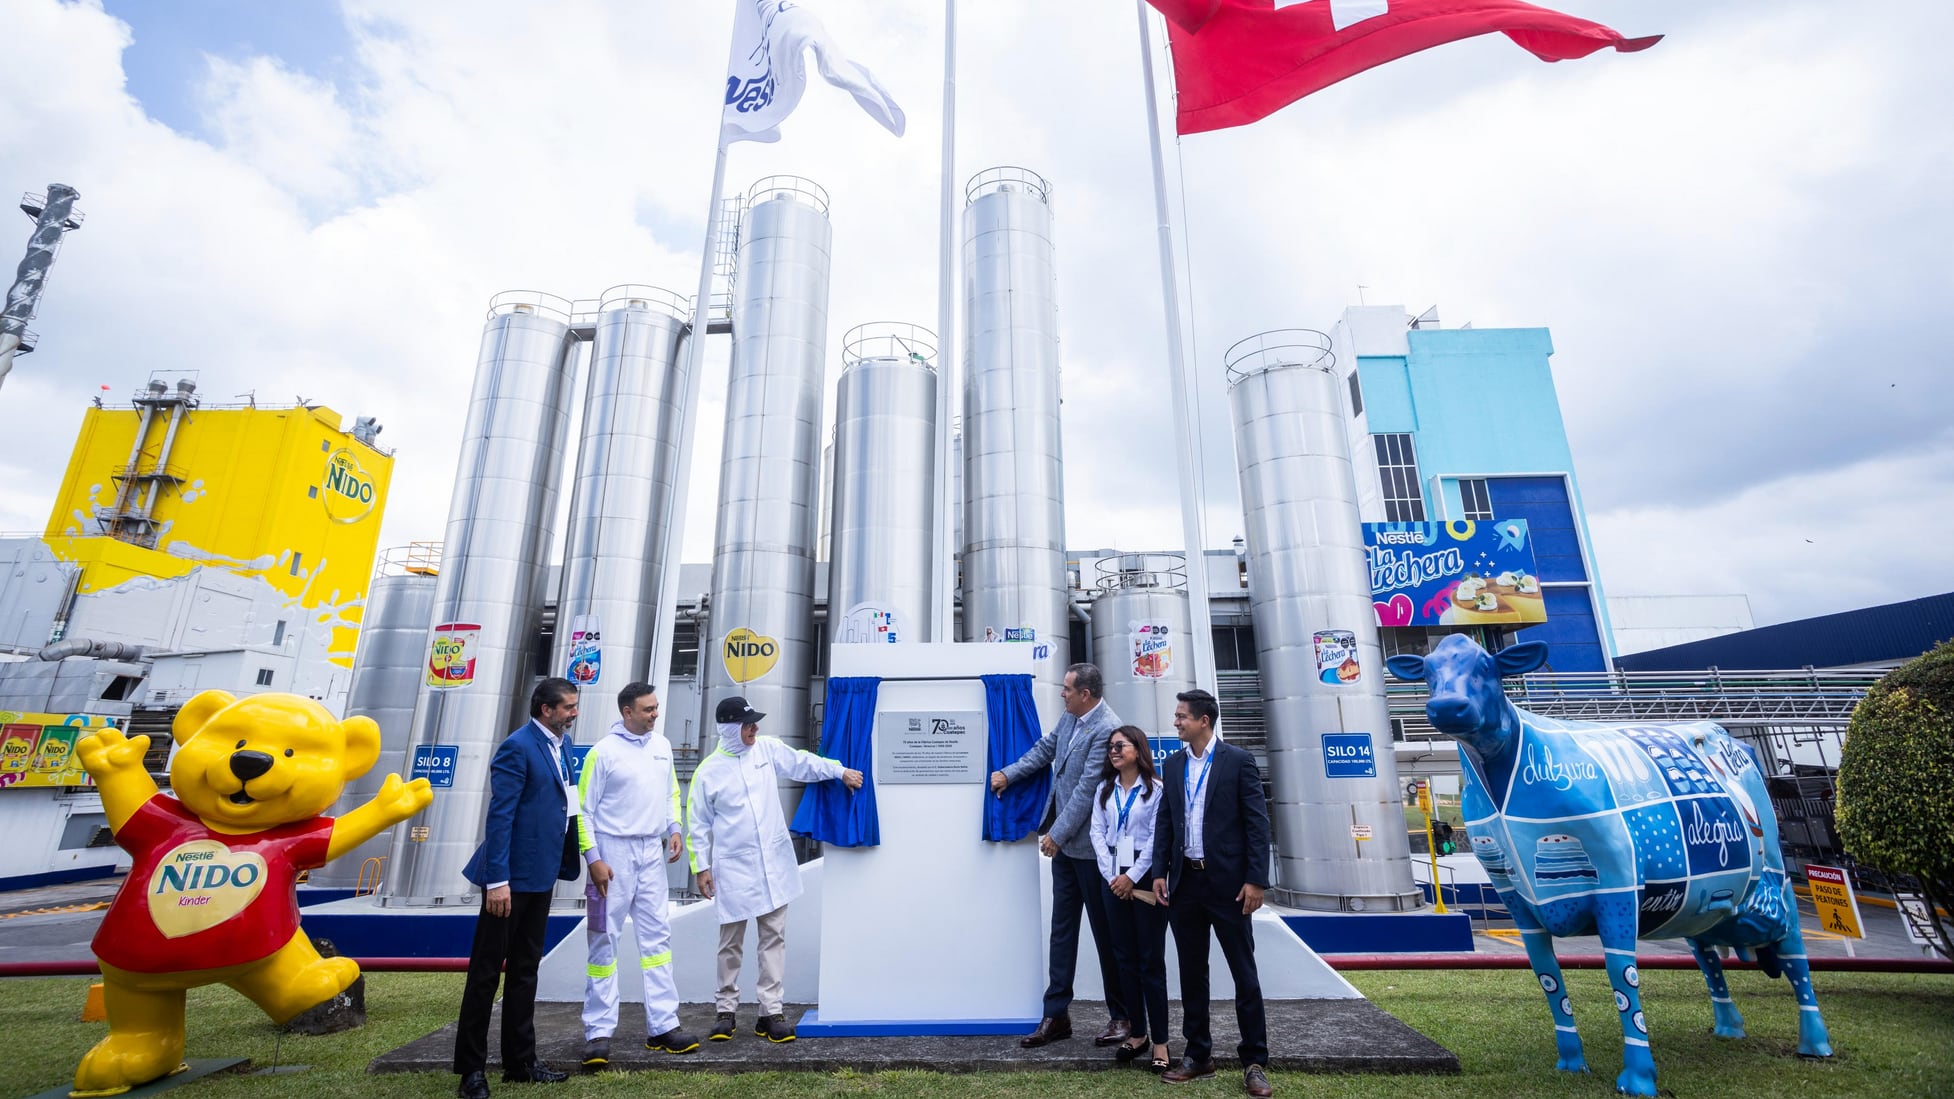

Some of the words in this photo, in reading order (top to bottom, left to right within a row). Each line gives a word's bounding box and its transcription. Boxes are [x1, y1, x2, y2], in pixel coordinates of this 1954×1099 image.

[326, 463, 372, 503] NIDO
[1376, 531, 1425, 544] Nestlé
[1372, 546, 1396, 570] La
[727, 641, 774, 658] NIDO
[4, 745, 27, 754] NIDO
[45, 745, 65, 754] NIDO
[1327, 745, 1356, 757] SILO
[1358, 745, 1371, 757] 14
[417, 756, 440, 767] SILO
[443, 757, 451, 767] 8
[1523, 743, 1599, 791] dulzura
[1688, 800, 1744, 867] alegría
[175, 851, 215, 862] Nestlé
[156, 862, 259, 894] NIDO
[1808, 869, 1842, 881] PRECAUCIÓN
[1815, 884, 1832, 895] PASO
[1832, 887, 1842, 896] DE
[178, 895, 211, 906] Kinder
[1640, 888, 1684, 912] entir
[1815, 894, 1849, 908] PEATONES
